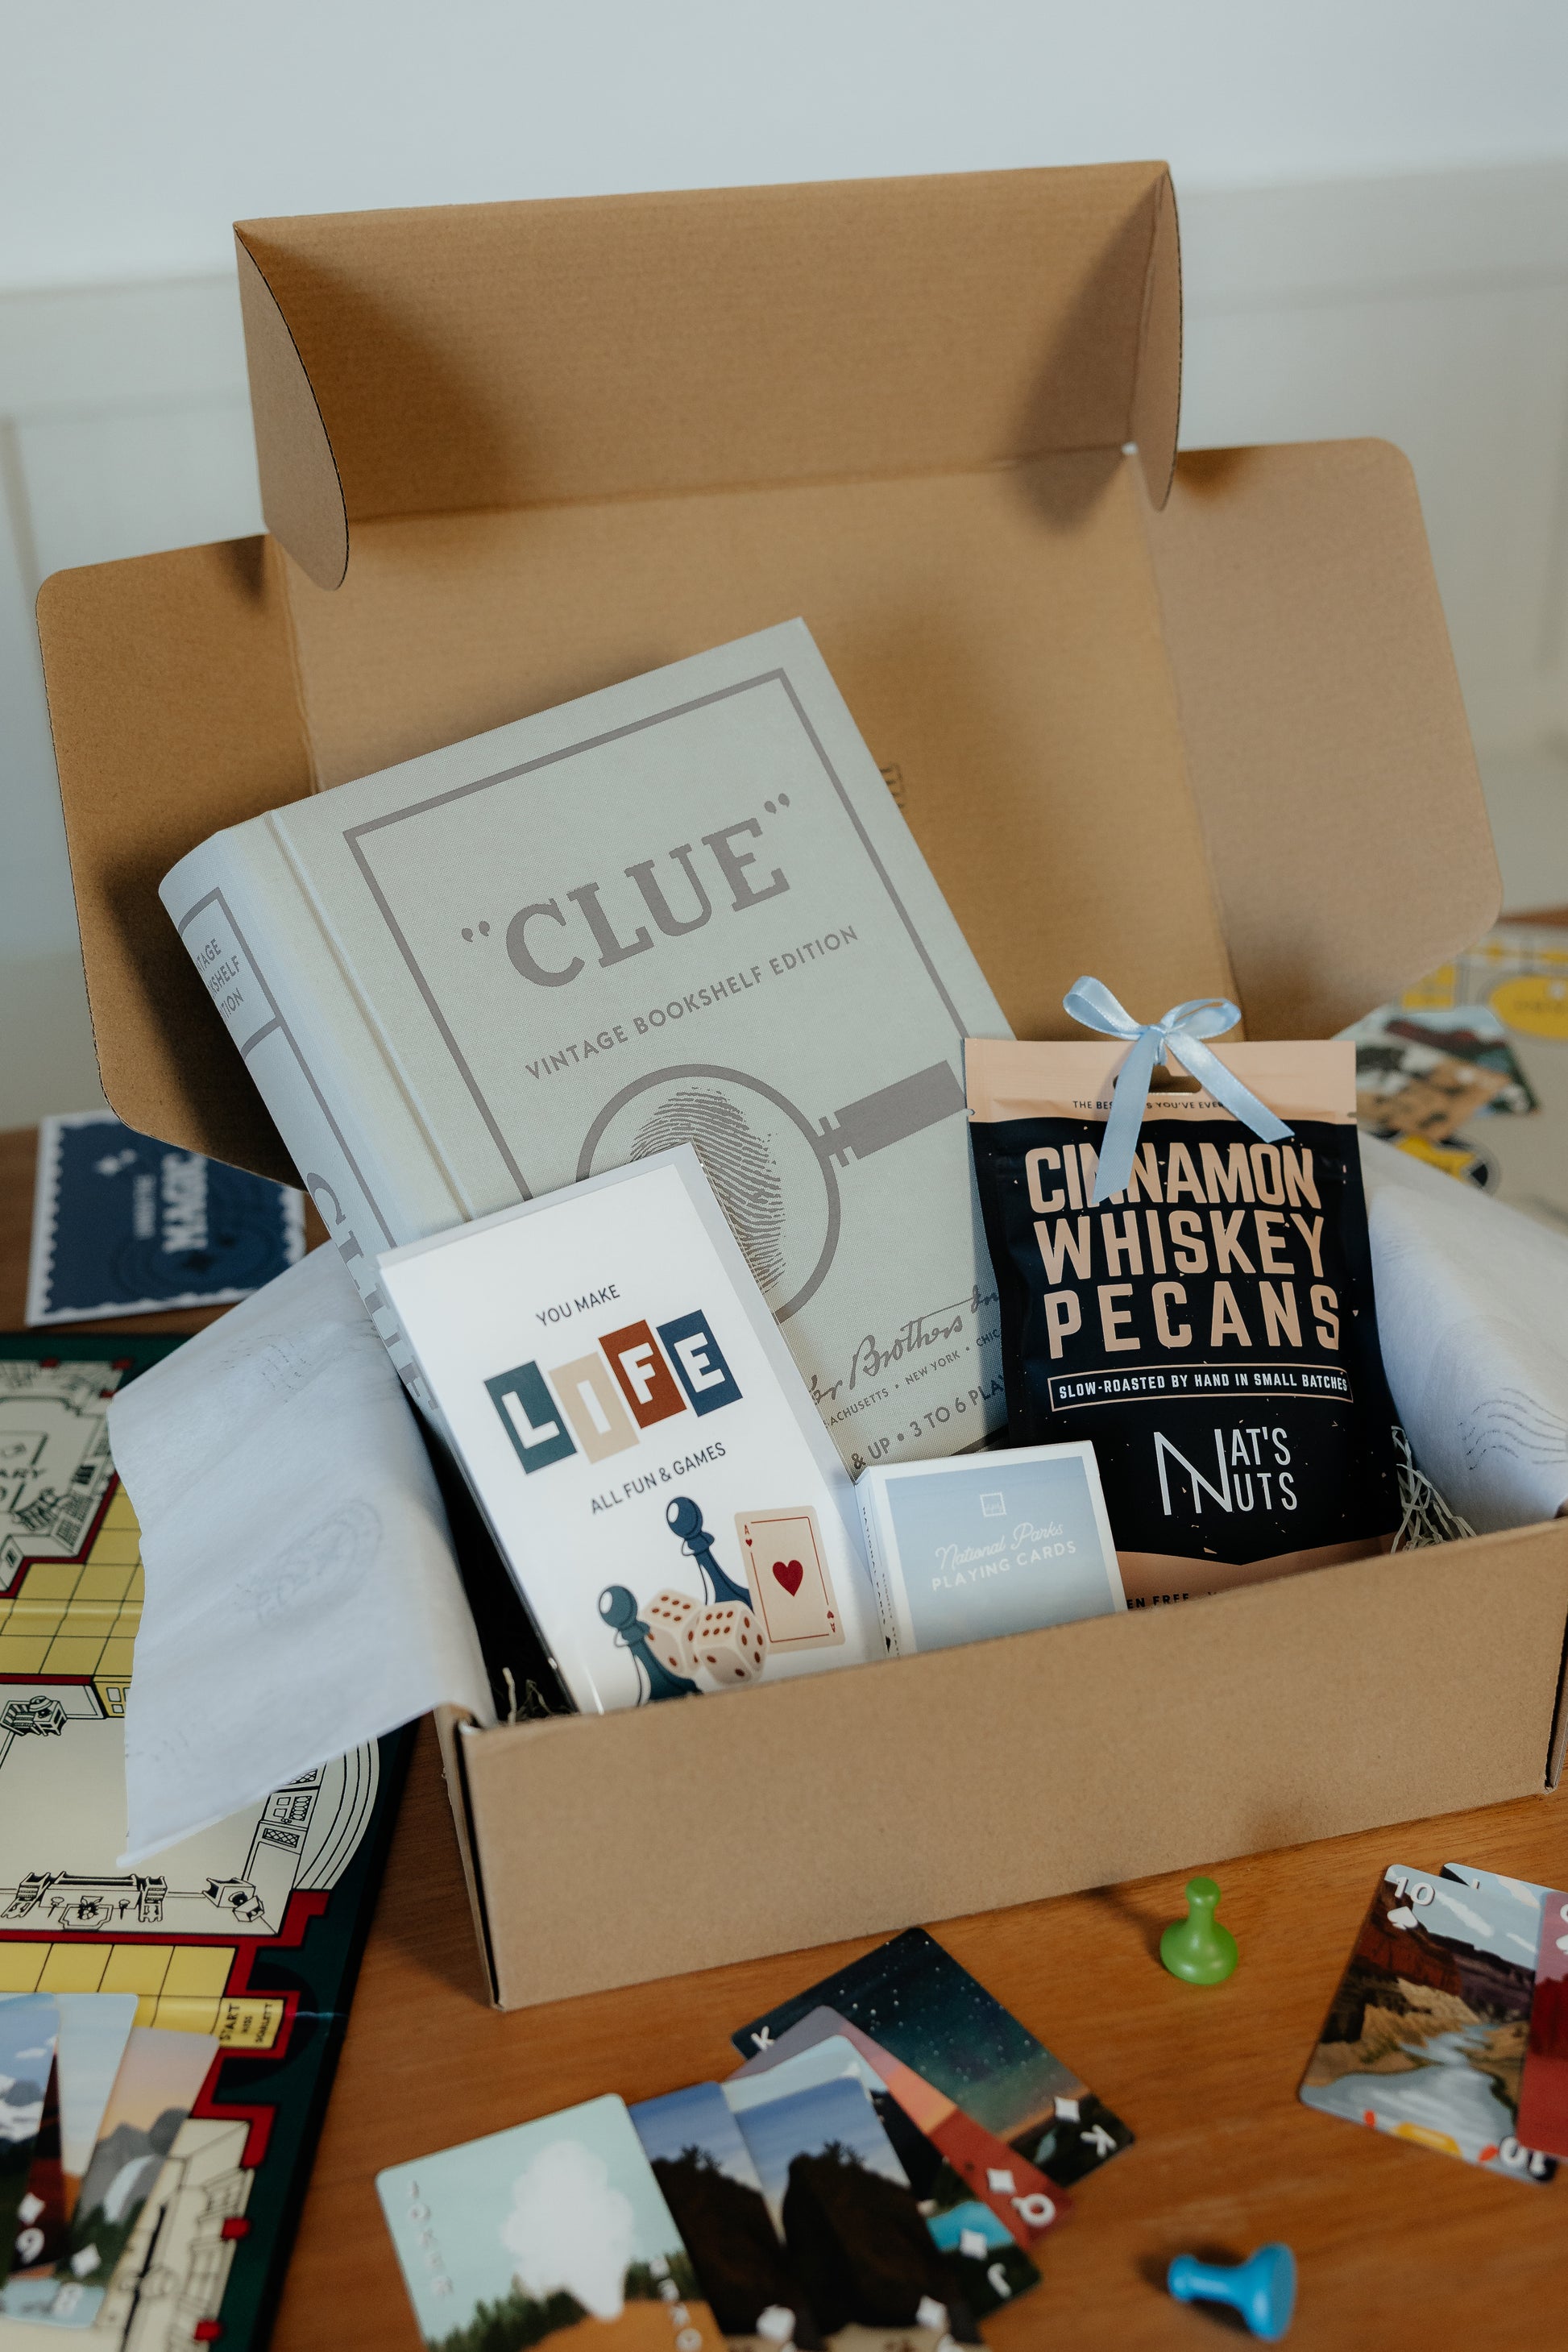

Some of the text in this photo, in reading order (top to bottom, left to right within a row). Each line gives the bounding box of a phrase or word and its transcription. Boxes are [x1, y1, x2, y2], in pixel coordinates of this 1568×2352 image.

[525, 925, 858, 1080] VINTAGE BOOKSHELF EDITION
[1072, 1101, 1092, 1109] THE
[1096, 1101, 1113, 1110] BES
[1155, 1101, 1195, 1110] YOU'VE
[1025, 1143, 1321, 1213] CINNAMON
[1033, 1209, 1324, 1285] WHISKEY
[535, 1284, 620, 1327] YOU MAKE
[1043, 1281, 1339, 1359] PECANS
[849, 1313, 963, 1390] Brothers
[499, 1329, 727, 1451] LIFE
[824, 1388, 890, 1428] ACHUSETTS
[905, 1366, 928, 1386] NEW
[930, 1350, 960, 1371] YORK
[1059, 1372, 1348, 1400] SLOW-ROASTED BY HAND IN SMALL BATCHES
[851, 1452, 866, 1470] &
[867, 1437, 890, 1460] UP
[909, 1421, 923, 1437] 3
[924, 1406, 950, 1429] TO
[955, 1396, 967, 1413] 6
[591, 1441, 727, 1514] ALL FUN & GAMES
[744, 1524, 750, 1534] A
[935, 1521, 1064, 1570] National Parks
[932, 1541, 1076, 1592] PLAYING CARDS
[1394, 1876, 1436, 1906] 10
[750, 2026, 775, 2051] K
[1081, 2124, 1117, 2157] K
[1011, 2192, 1056, 2227] Q
